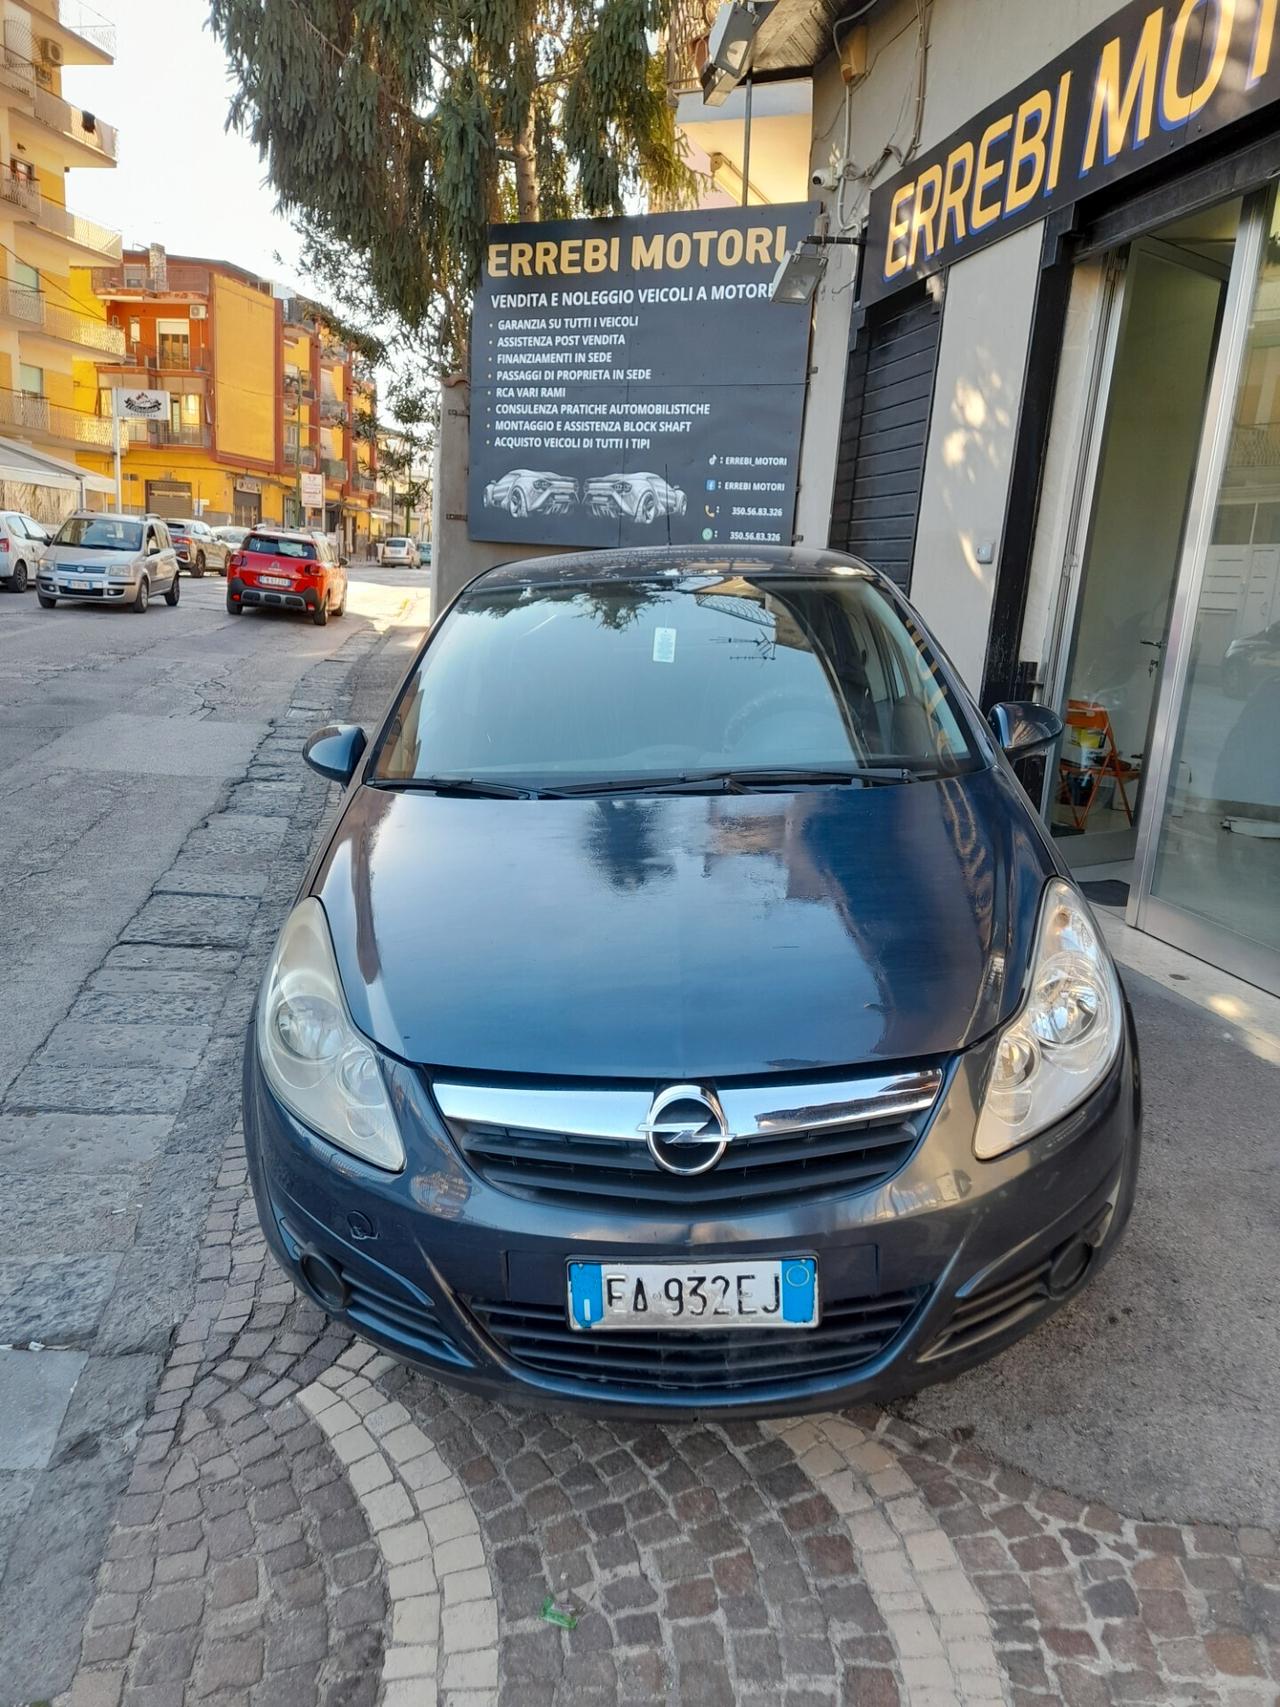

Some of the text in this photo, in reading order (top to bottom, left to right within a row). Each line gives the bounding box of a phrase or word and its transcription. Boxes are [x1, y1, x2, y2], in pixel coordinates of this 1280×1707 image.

[882, 70, 1072, 282] ERREBI
[488, 226, 787, 278] ERREBI MOTORI
[491, 293, 548, 309] VENDITA
[551, 293, 559, 307] E
[562, 289, 634, 306] NOLEGGIO
[638, 287, 693, 303] VEICOLI
[696, 286, 707, 301] A
[498, 316, 638, 330] GARANZIA SU TUTTI I VEICOLI
[497, 334, 625, 347] ASSISTENZA POST VENDITA
[497, 352, 612, 364] FINANZIAMENTI IN SEDE
[497, 369, 652, 381] PASSAGGI DI PROPRIETA IN SEDE
[496, 387, 566, 397] RCA VARI RAMI
[495, 403, 710, 415] CONSULENZA PRATICHE AUTOMOBILISTICHE
[495, 420, 692, 432] MONTAGGIO E ASSISTENZA BLOCK SHAFT
[494, 437, 650, 449] ACQUISTO VEICOLI DI TUTTI I TIPI
[724, 482, 785, 492] ERREBI MOTORI
